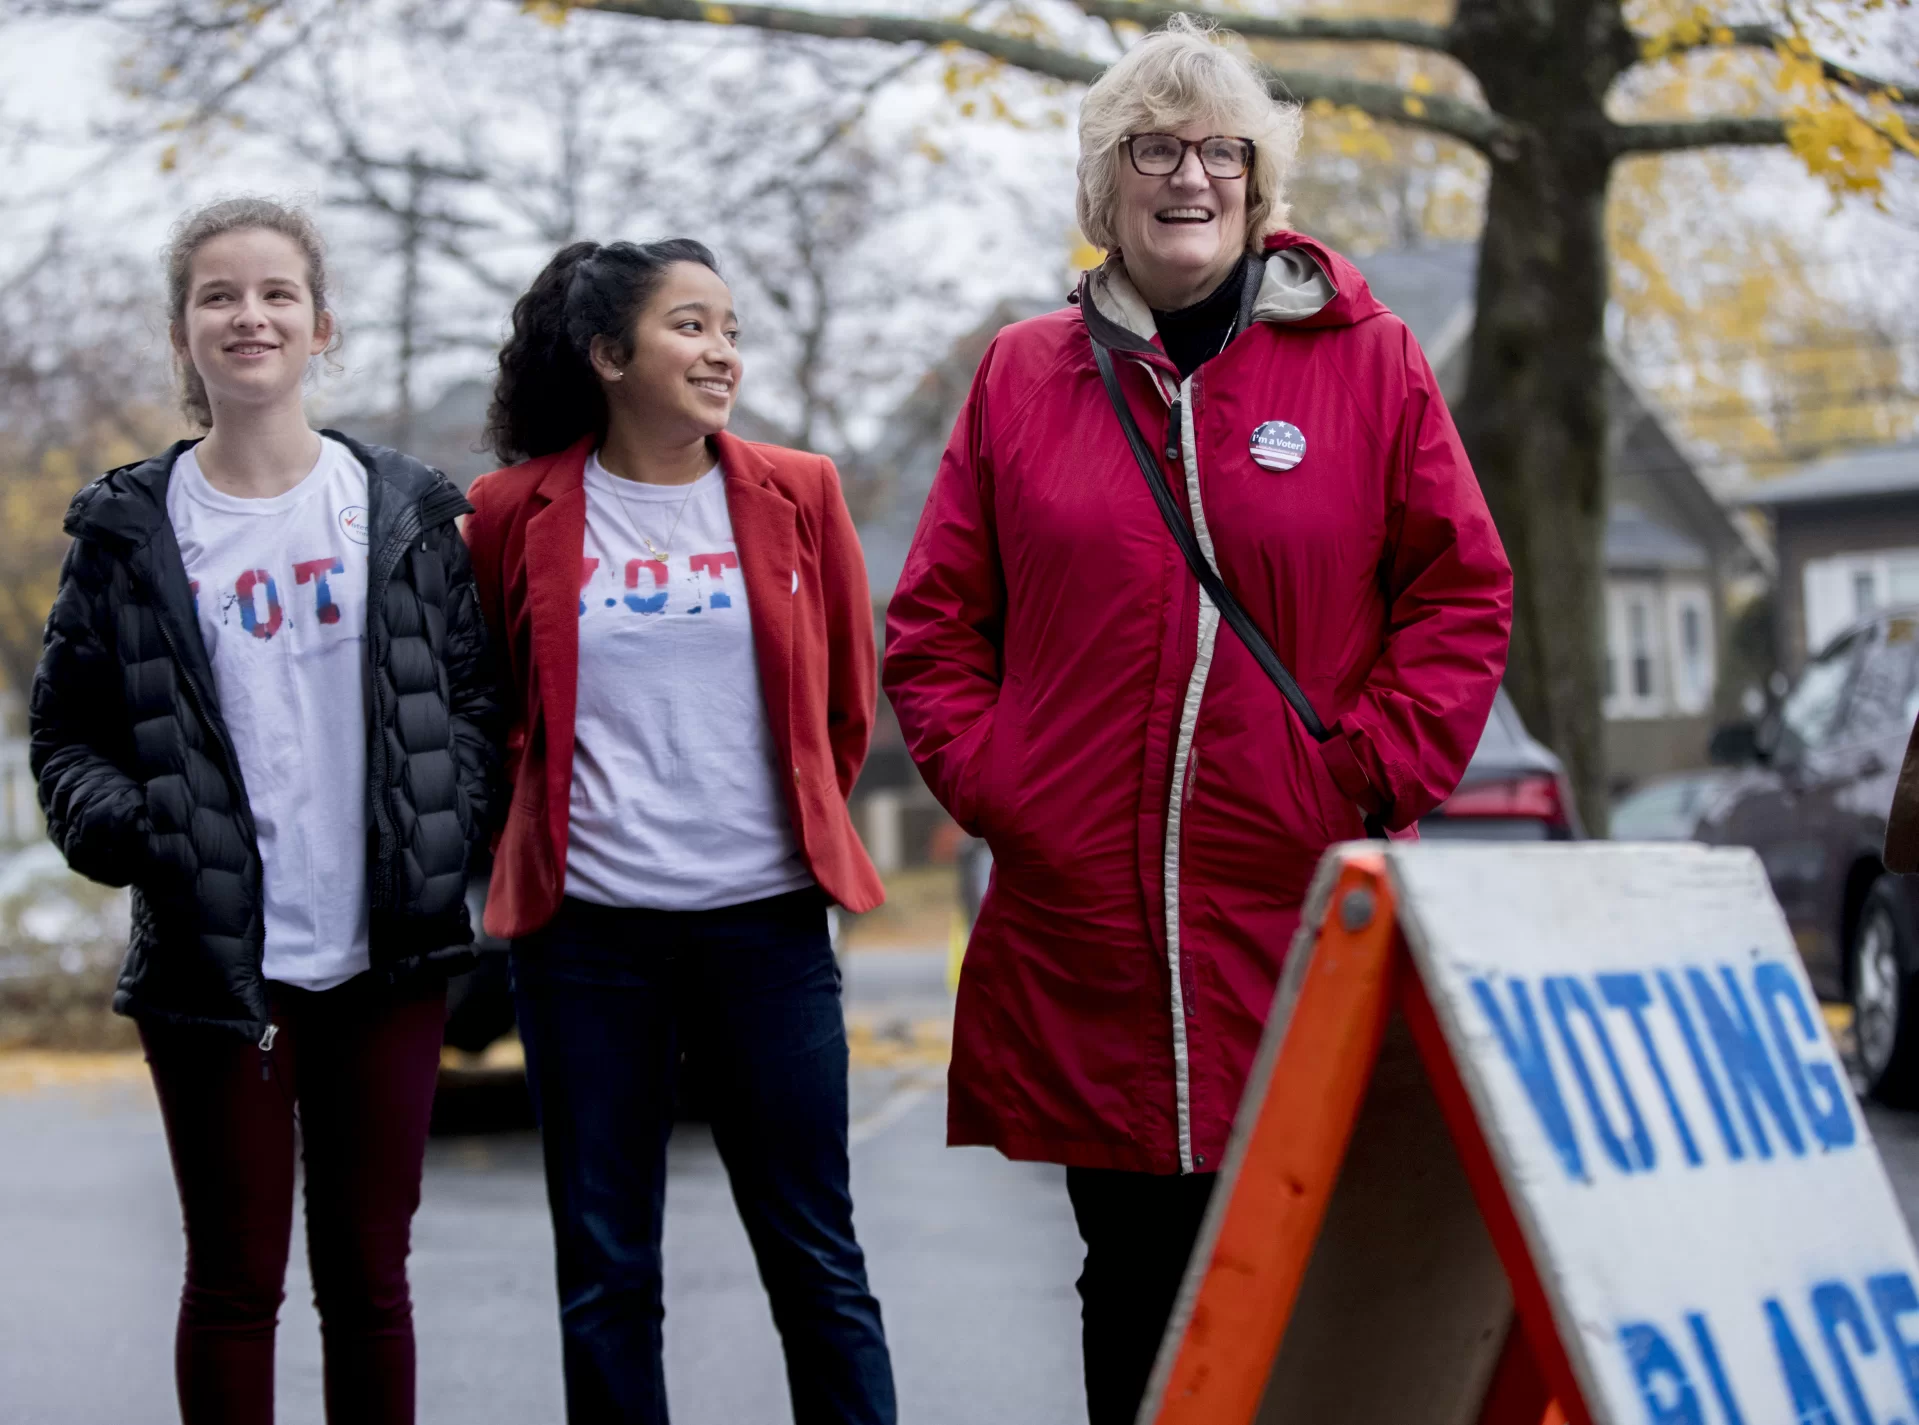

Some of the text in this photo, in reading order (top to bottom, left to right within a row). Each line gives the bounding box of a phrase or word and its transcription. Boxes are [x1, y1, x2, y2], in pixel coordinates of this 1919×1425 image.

[1252, 434, 1268, 444] I'm
[1276, 438, 1304, 451] Voter!
[189, 556, 345, 642] OT
[1467, 961, 1857, 1184] VOTING
